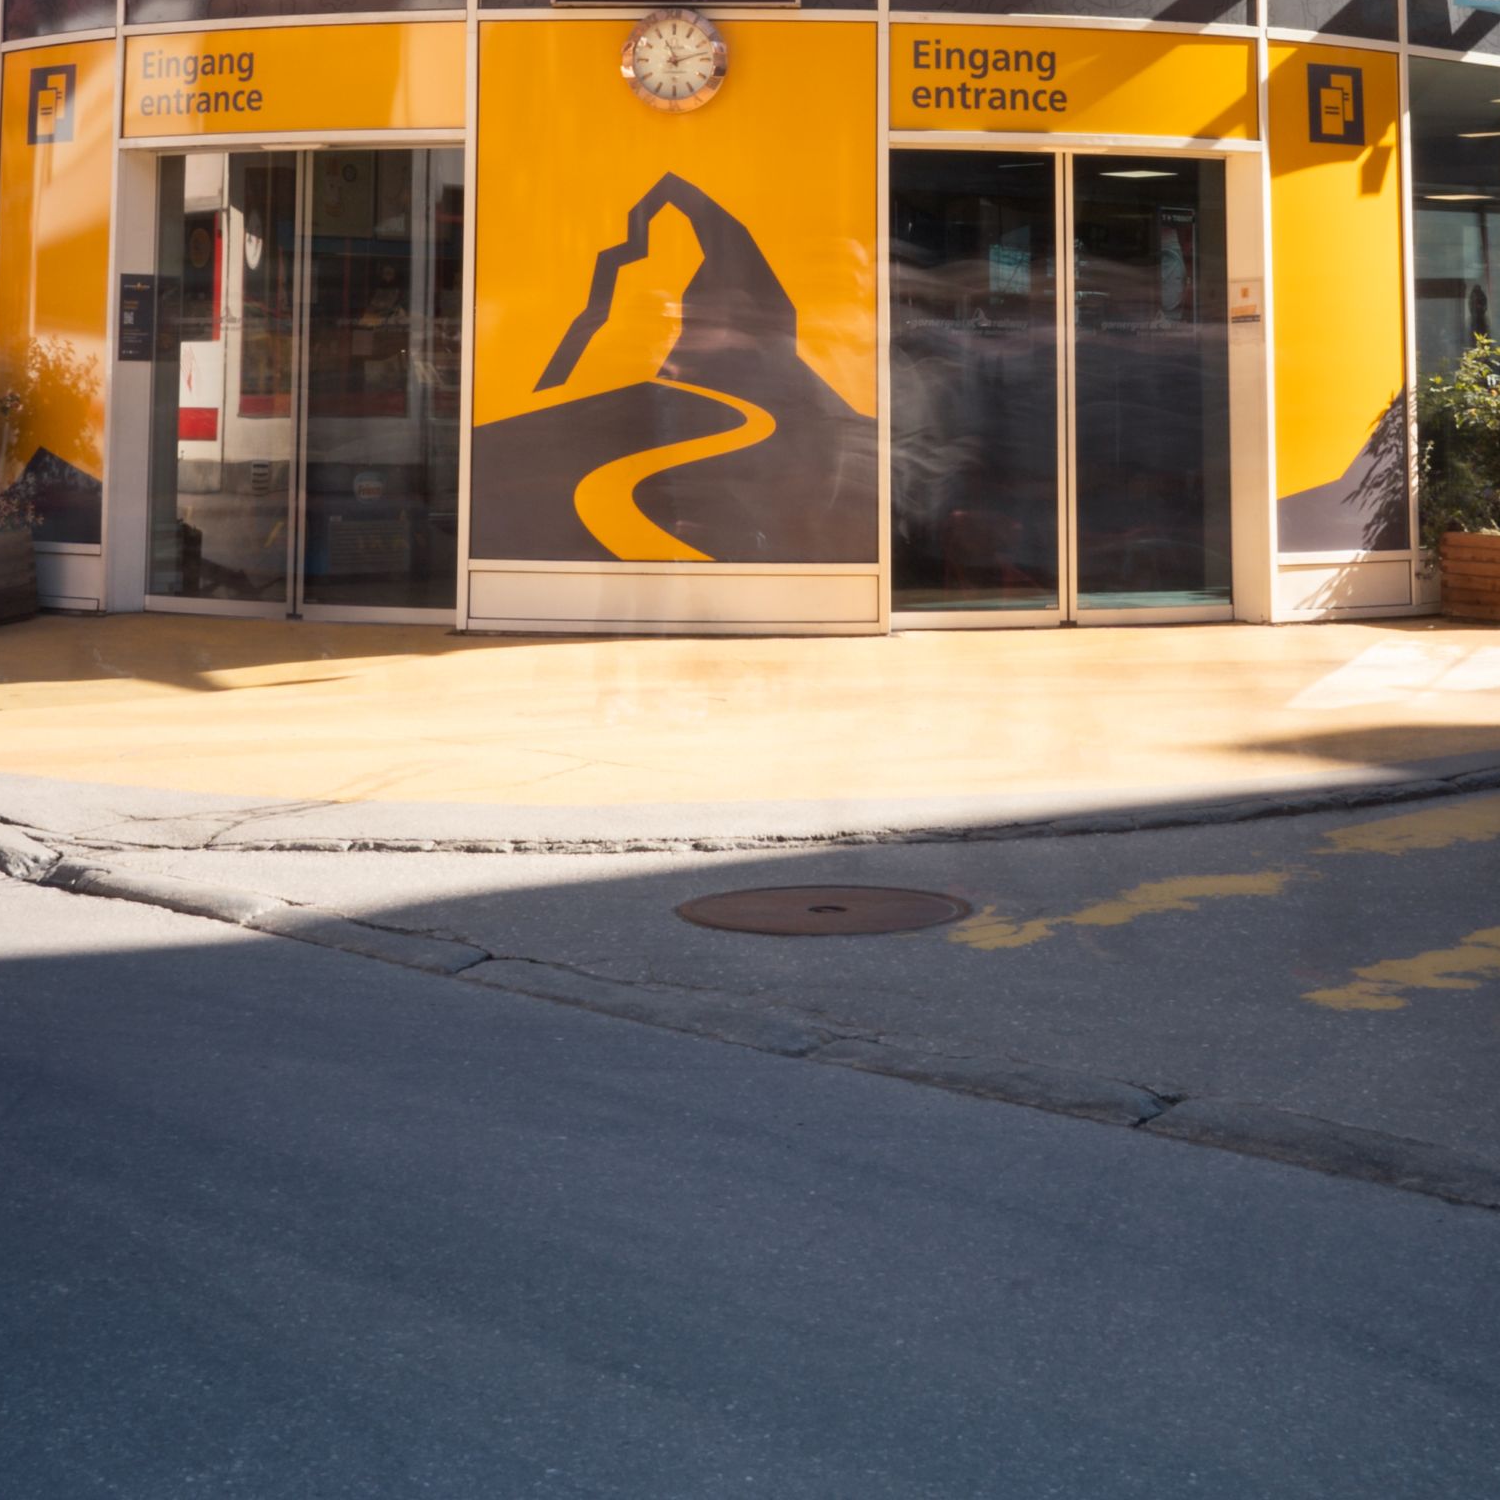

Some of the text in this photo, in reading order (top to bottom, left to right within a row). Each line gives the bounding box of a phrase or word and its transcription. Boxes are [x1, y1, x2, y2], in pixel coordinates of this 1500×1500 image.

[140, 48, 255, 85] Eingang
[913, 40, 1056, 82] Eingang
[139, 86, 263, 116] entrance
[911, 81, 1068, 113] entrance
